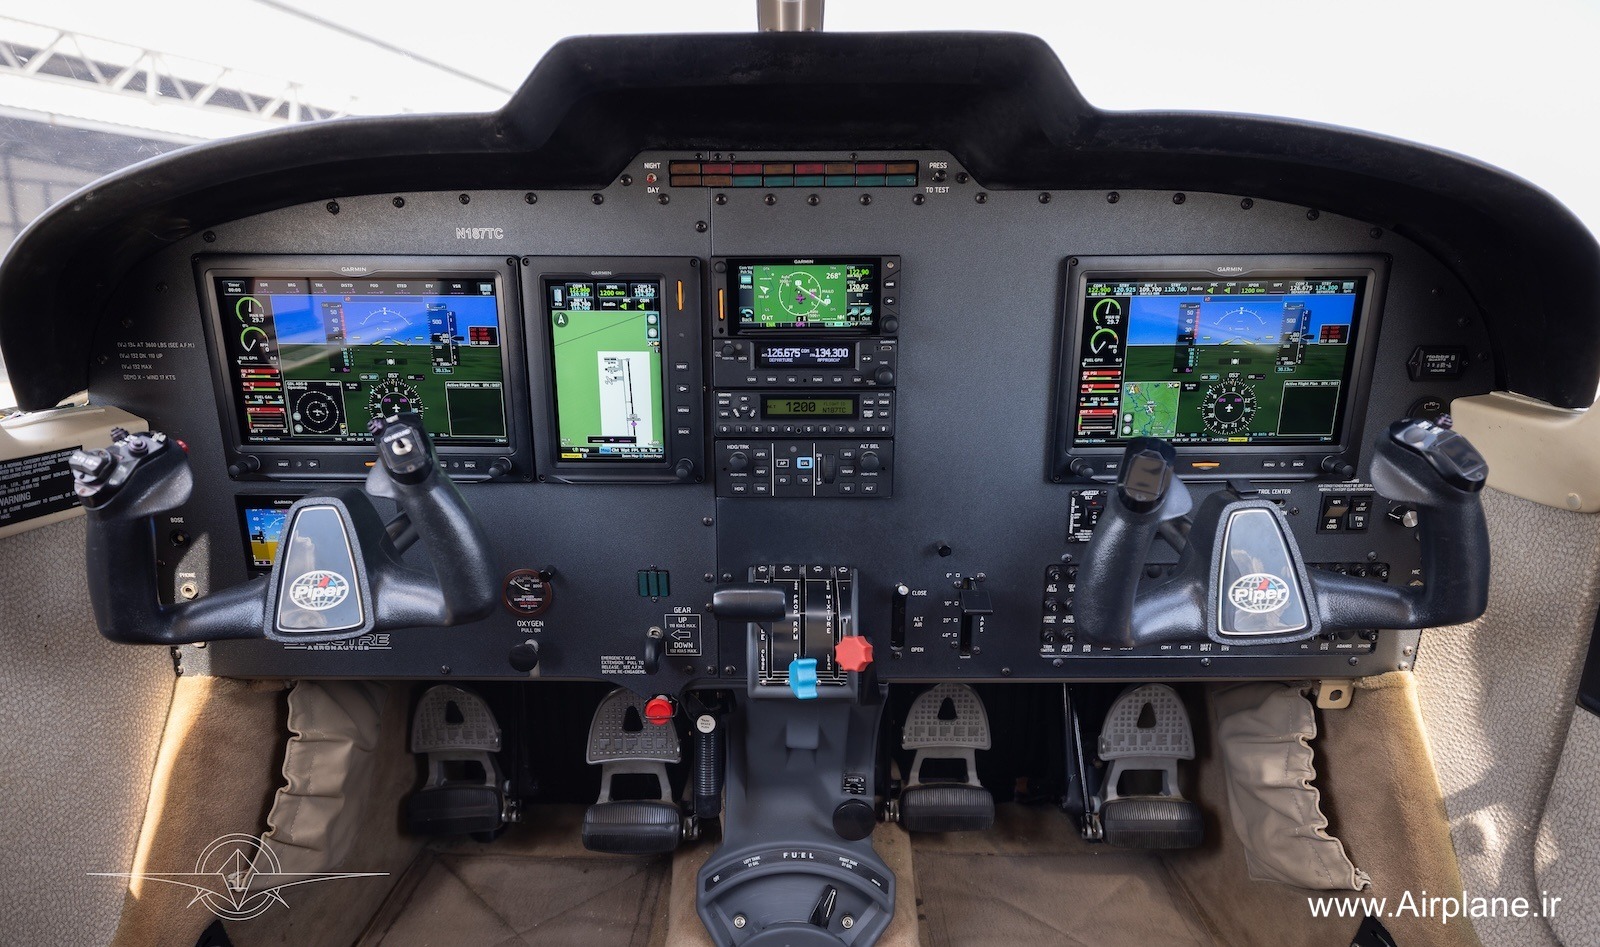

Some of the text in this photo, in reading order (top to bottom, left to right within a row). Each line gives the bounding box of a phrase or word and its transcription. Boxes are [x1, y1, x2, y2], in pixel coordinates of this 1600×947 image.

[456, 228, 504, 240] N187TC
[767, 348, 800, 357] 126.675
[815, 348, 848, 357] 134.300
[786, 402, 816, 412] 1200
[294, 586, 347, 601] Piper
[1234, 587, 1286, 602] Piper
